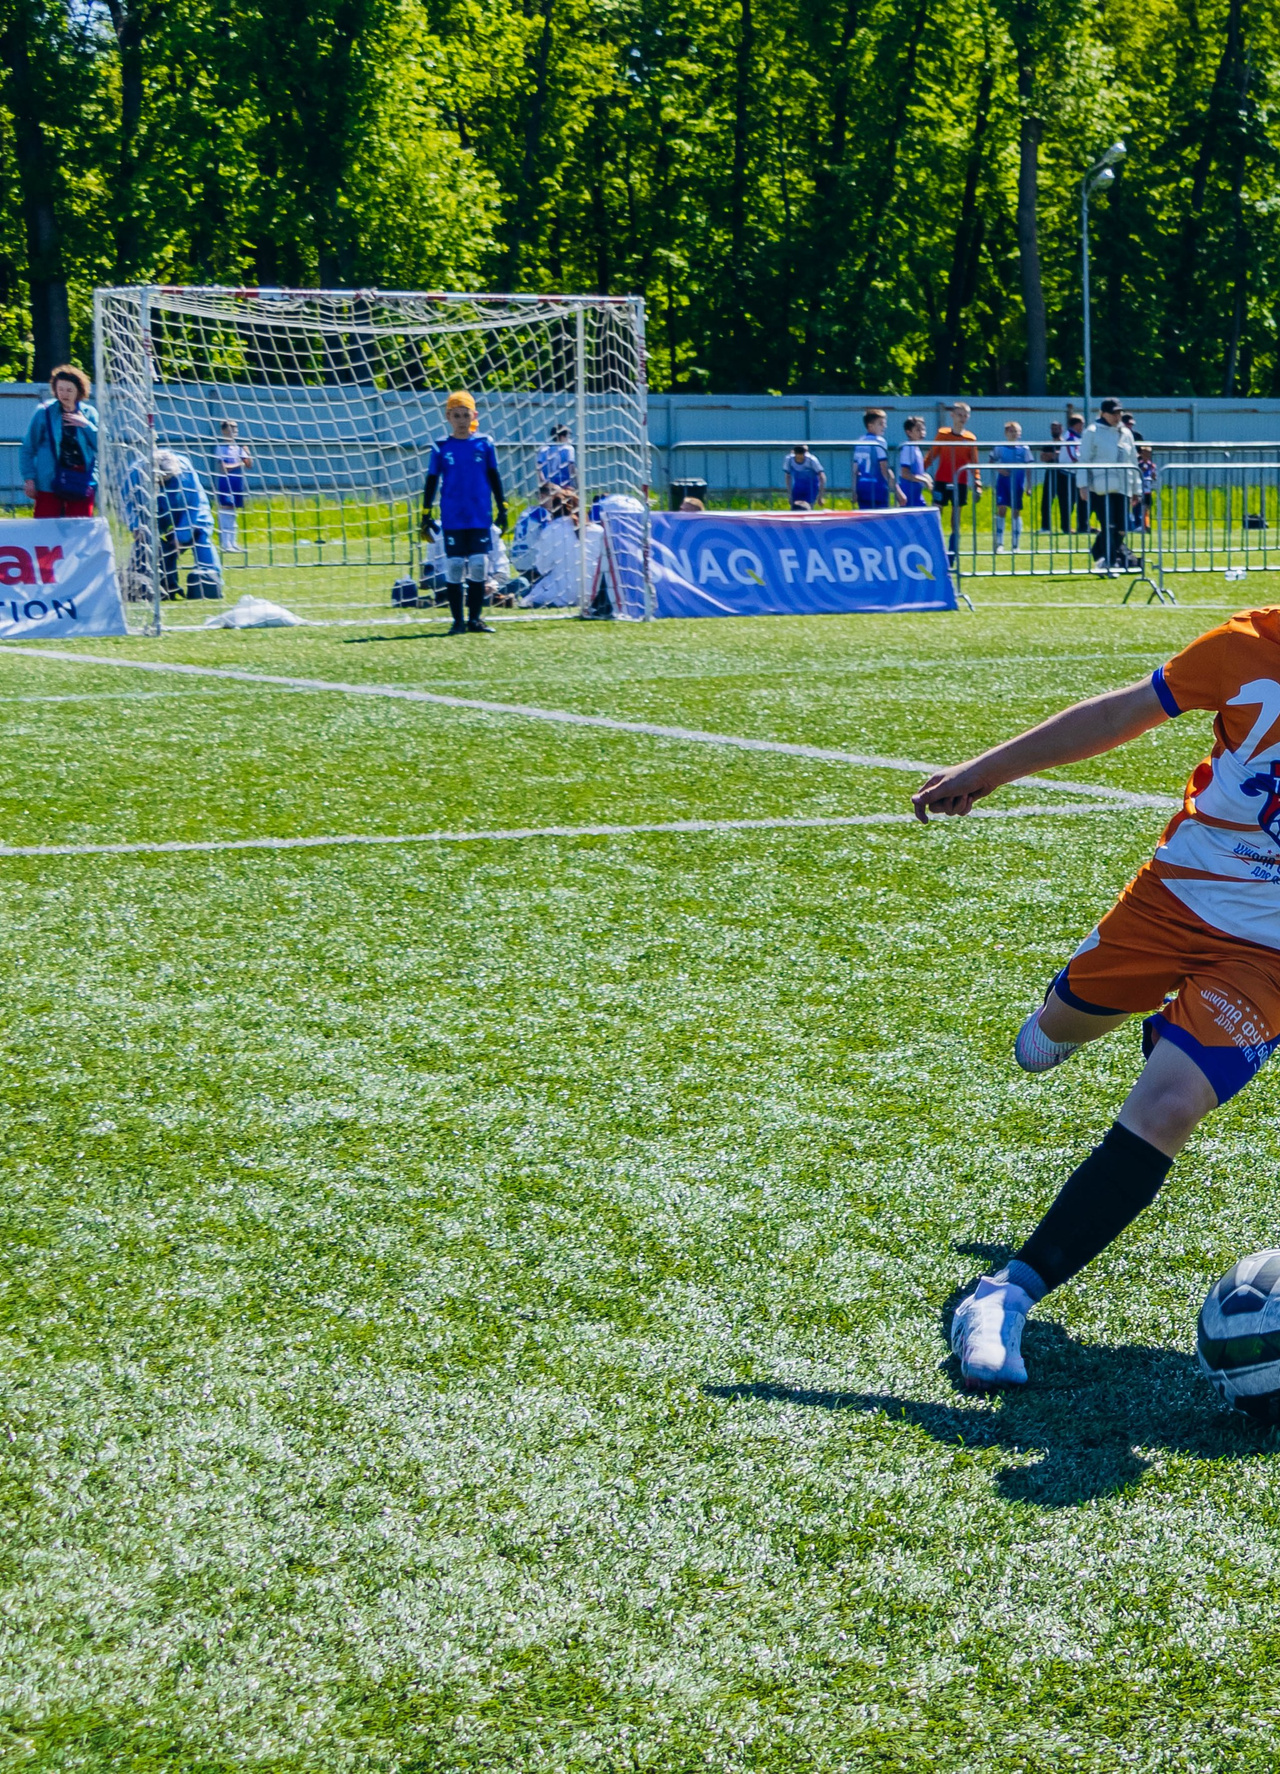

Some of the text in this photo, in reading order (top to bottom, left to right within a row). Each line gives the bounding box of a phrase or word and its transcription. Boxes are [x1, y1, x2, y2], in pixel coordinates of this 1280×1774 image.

[779, 543, 936, 584] FABRIQ
[1233, 843, 1276, 870] ШКОЛА
[1213, 1013, 1257, 1063] ДЛЯ ДЕТЕЙ
